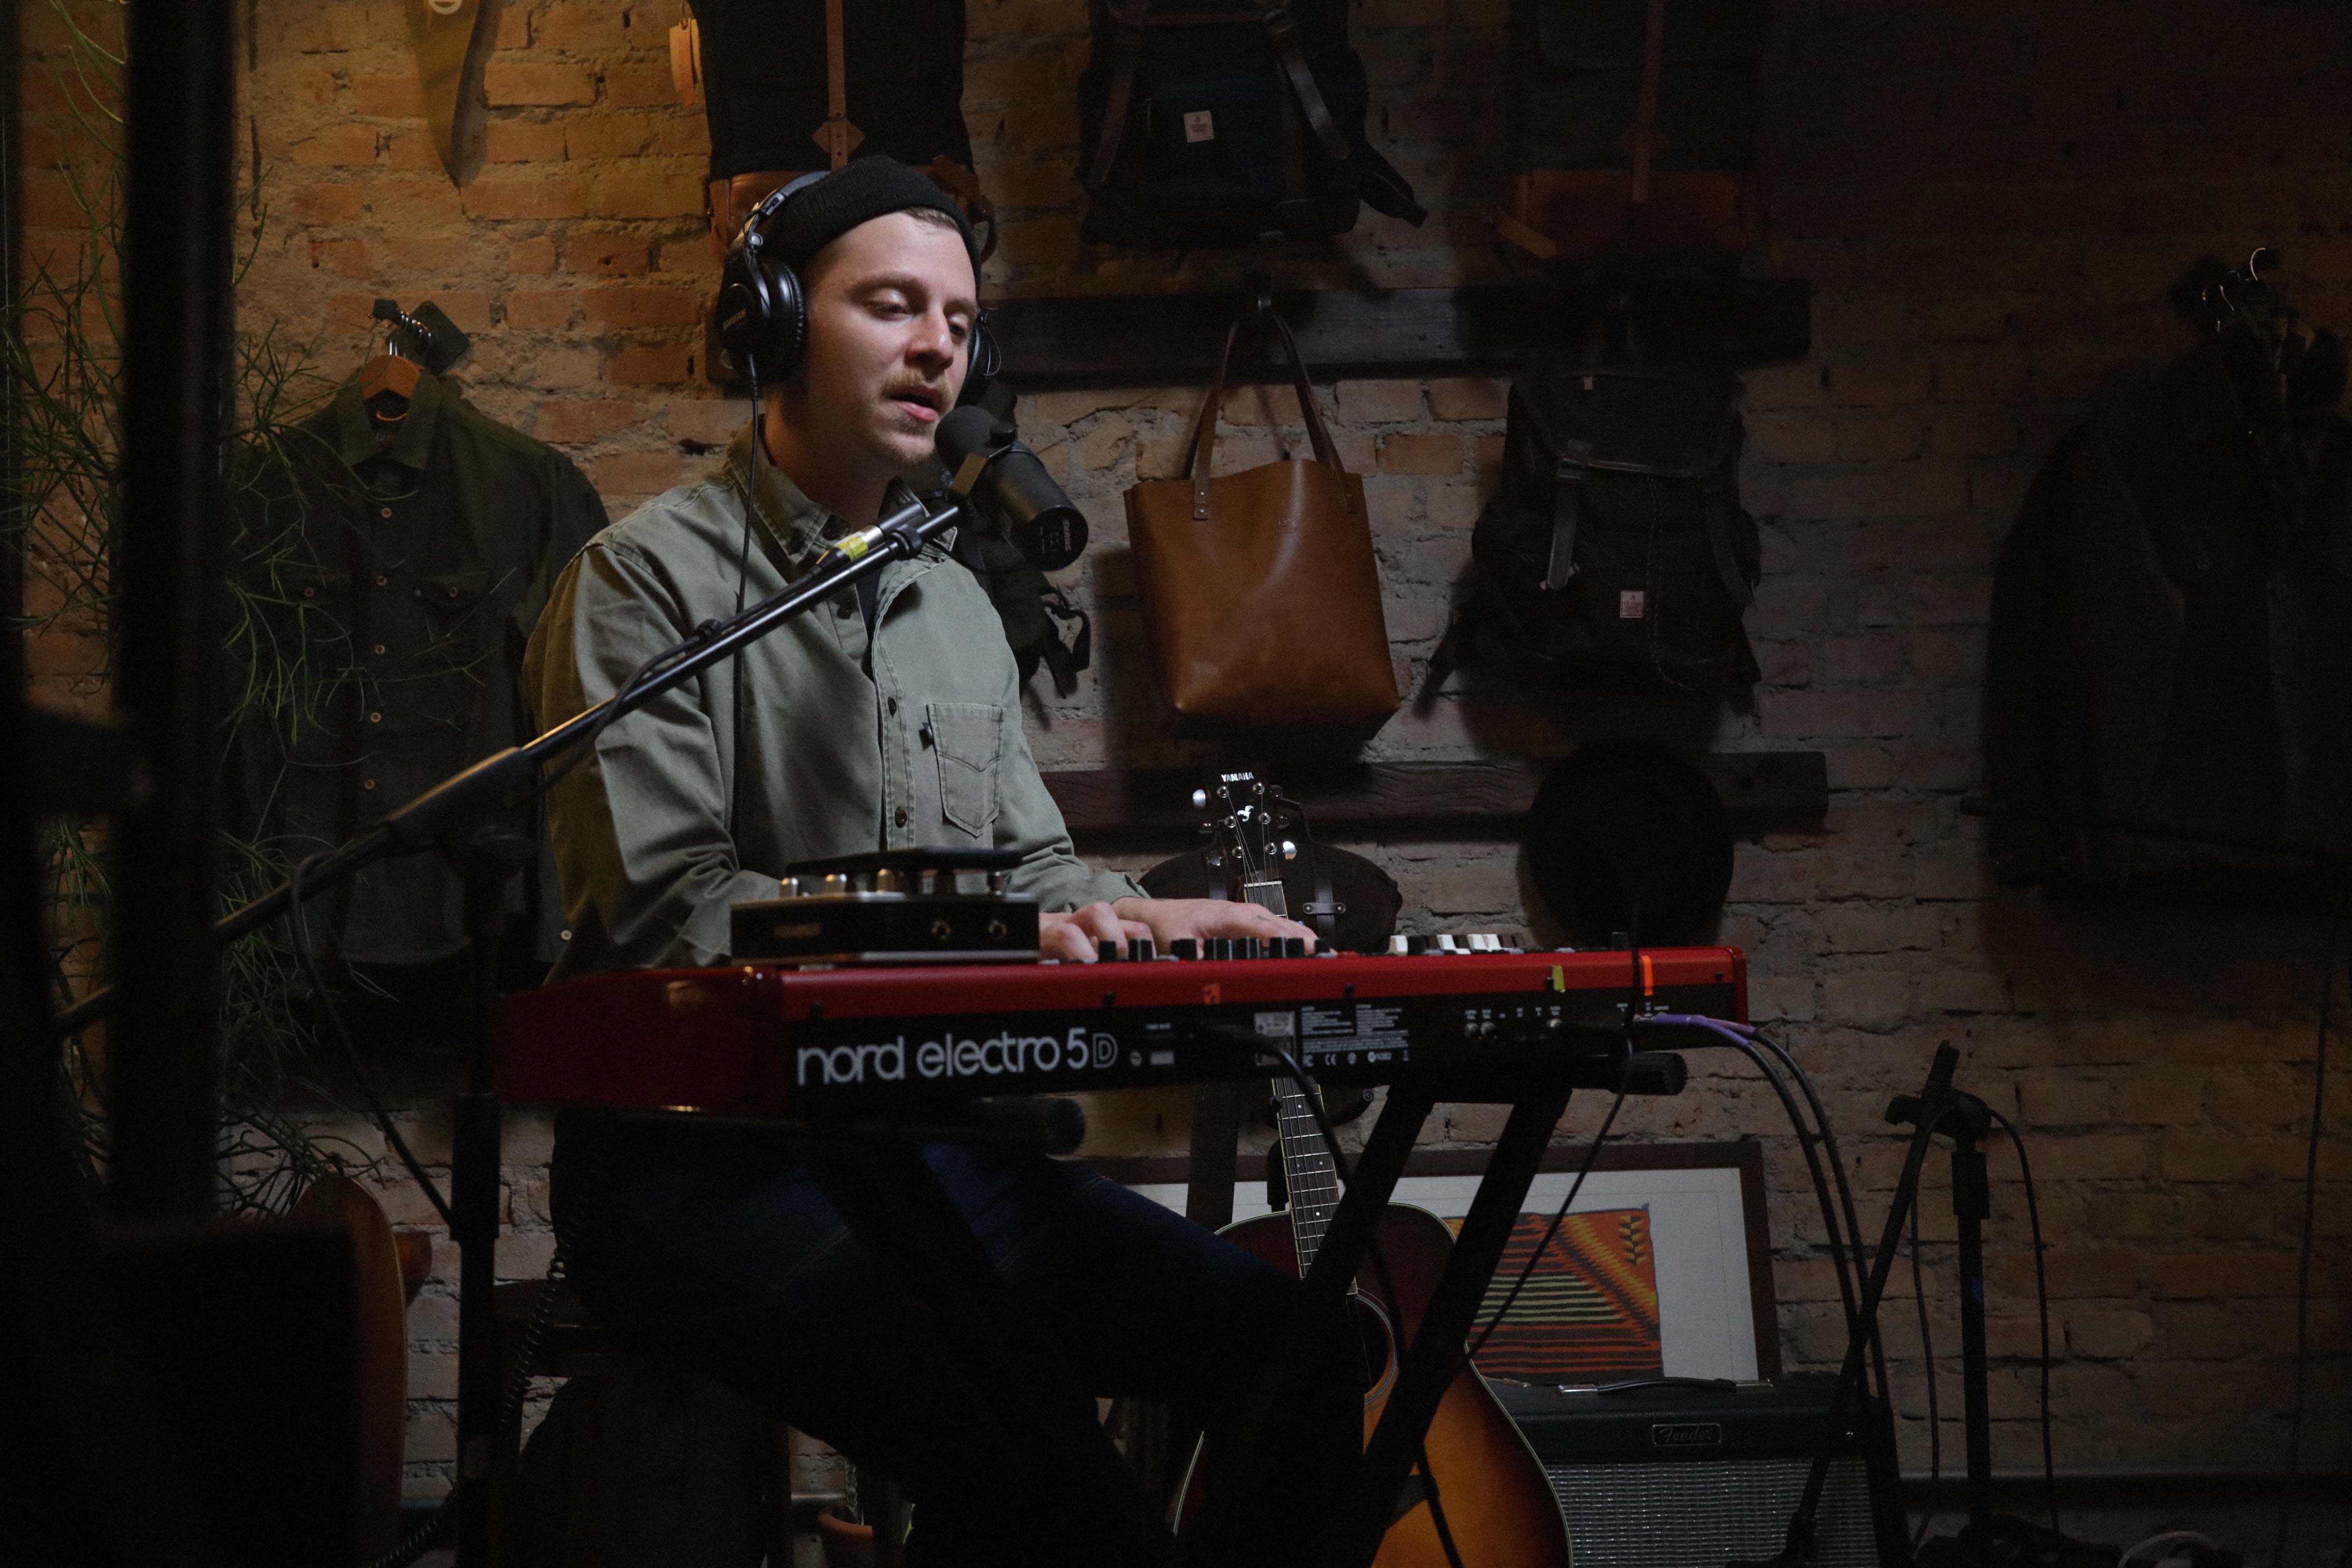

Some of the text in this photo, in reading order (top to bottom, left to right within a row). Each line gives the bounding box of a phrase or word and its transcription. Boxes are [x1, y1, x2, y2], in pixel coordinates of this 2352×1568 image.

[1221, 772, 1254, 782] YAMAHA
[798, 1036, 905, 1085] nord
[917, 1031, 1061, 1077] electro
[1659, 1427, 1711, 1444] Fender
